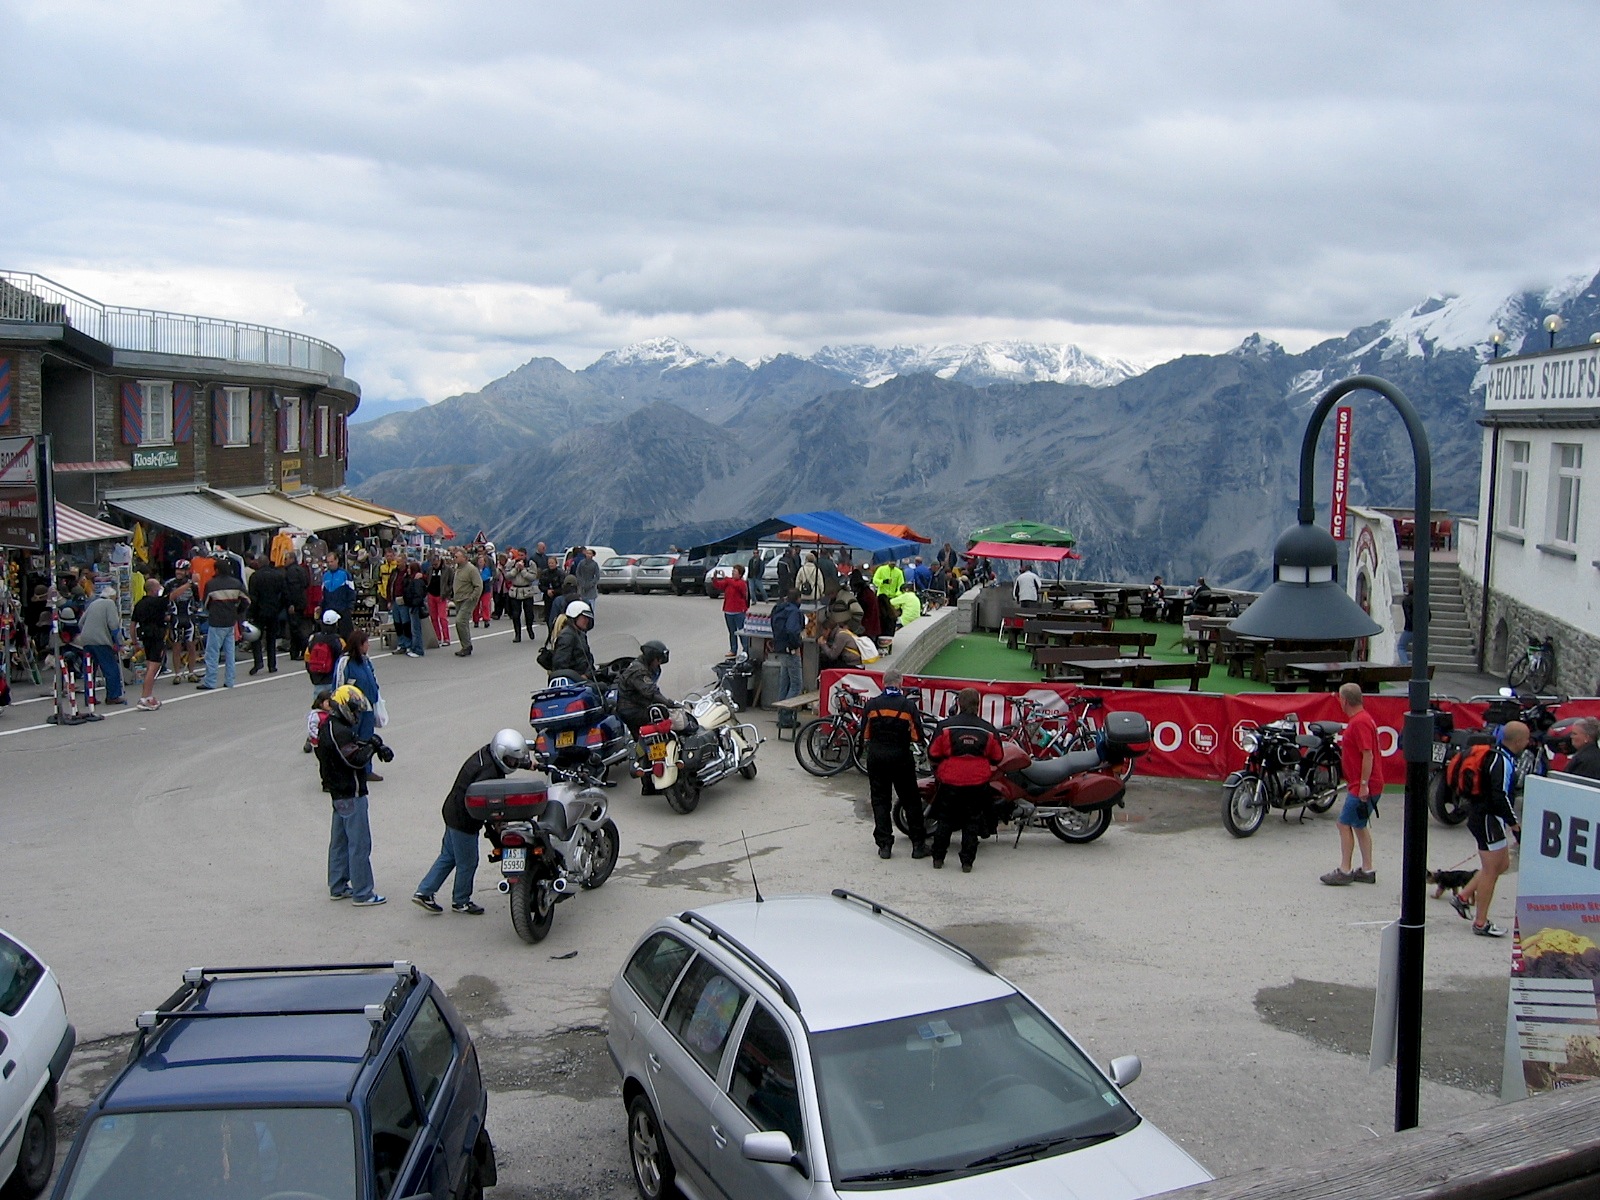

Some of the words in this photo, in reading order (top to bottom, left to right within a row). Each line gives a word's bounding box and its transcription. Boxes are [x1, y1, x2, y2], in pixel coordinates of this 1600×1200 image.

[1495, 364, 1535, 400] HOTEL
[1541, 356, 1600, 399] STILFS
[1333, 411, 1348, 537] SELFSERVICE
[503, 860, 525, 870] 55930
